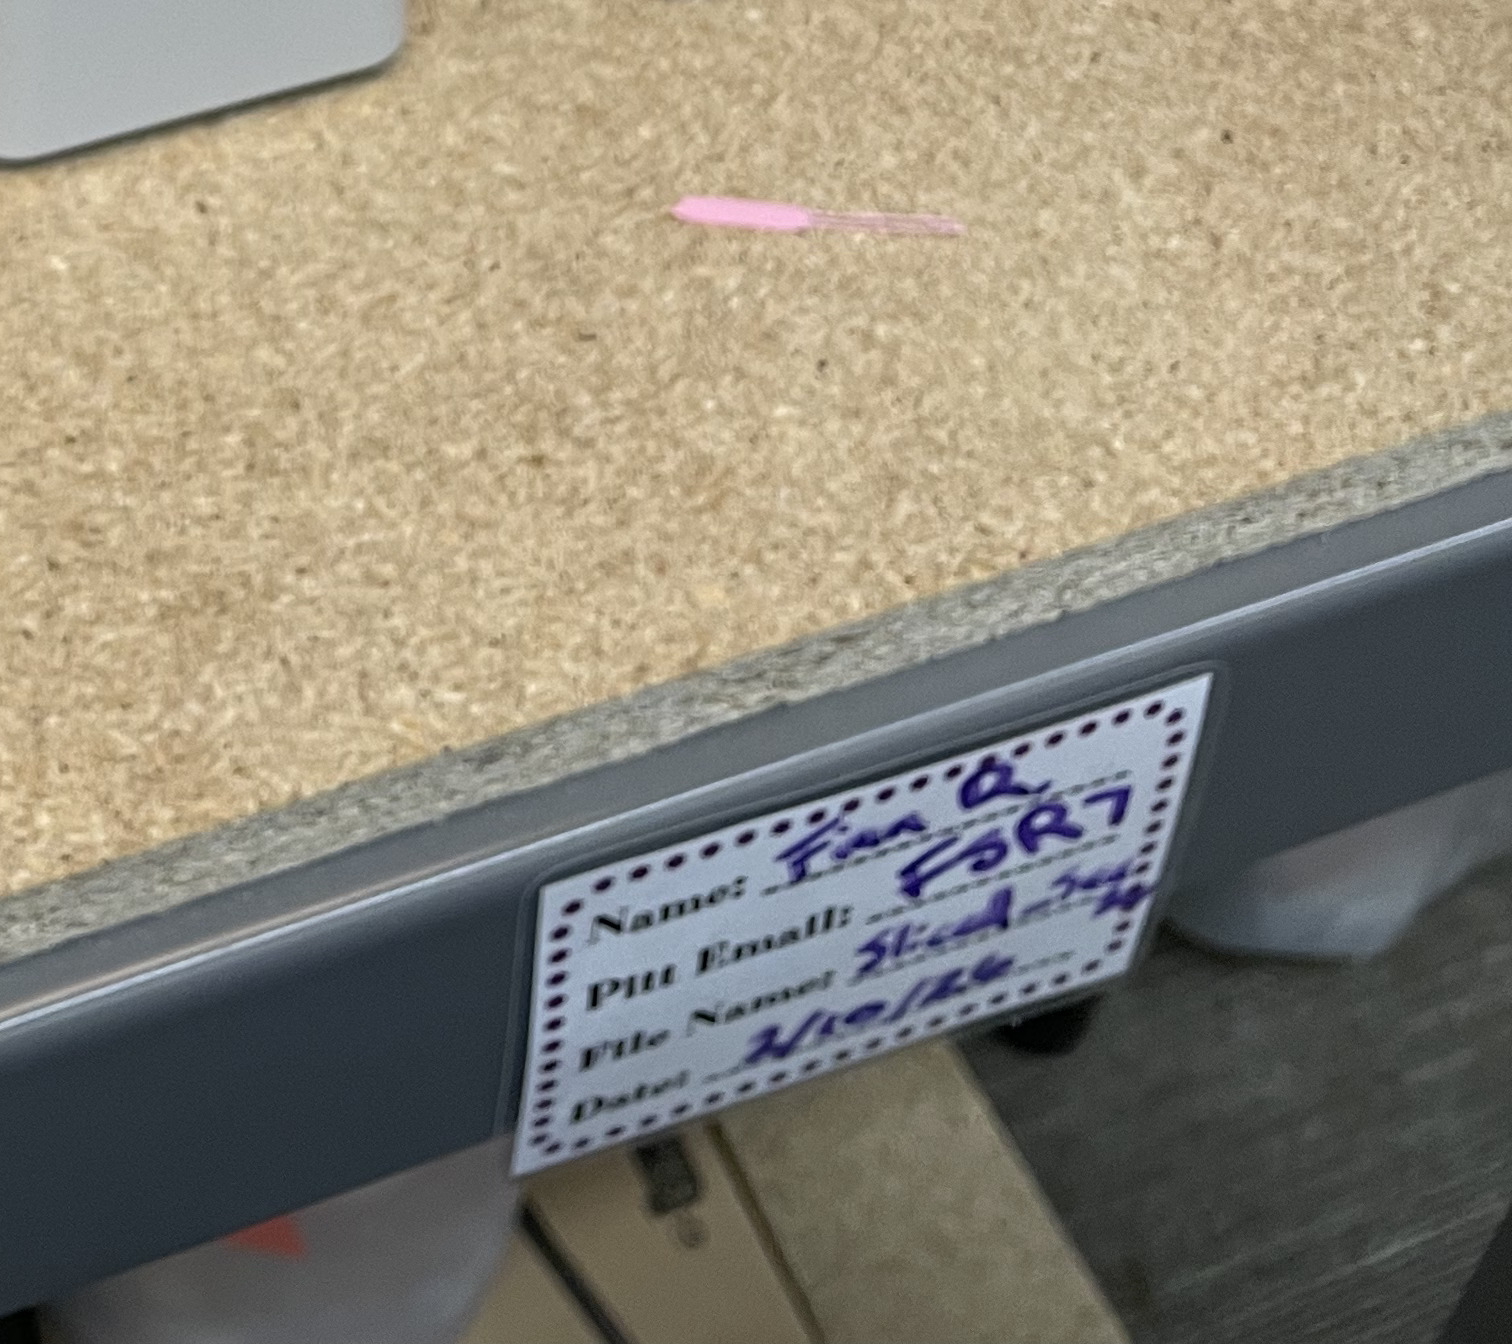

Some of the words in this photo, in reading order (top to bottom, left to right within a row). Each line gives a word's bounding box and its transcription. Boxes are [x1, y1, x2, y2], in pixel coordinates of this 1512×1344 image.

[587, 875, 749, 945] Name:
[694, 905, 854, 978] Email:
[579, 1028, 671, 1073] File
[569, 1069, 691, 1125] Date:
